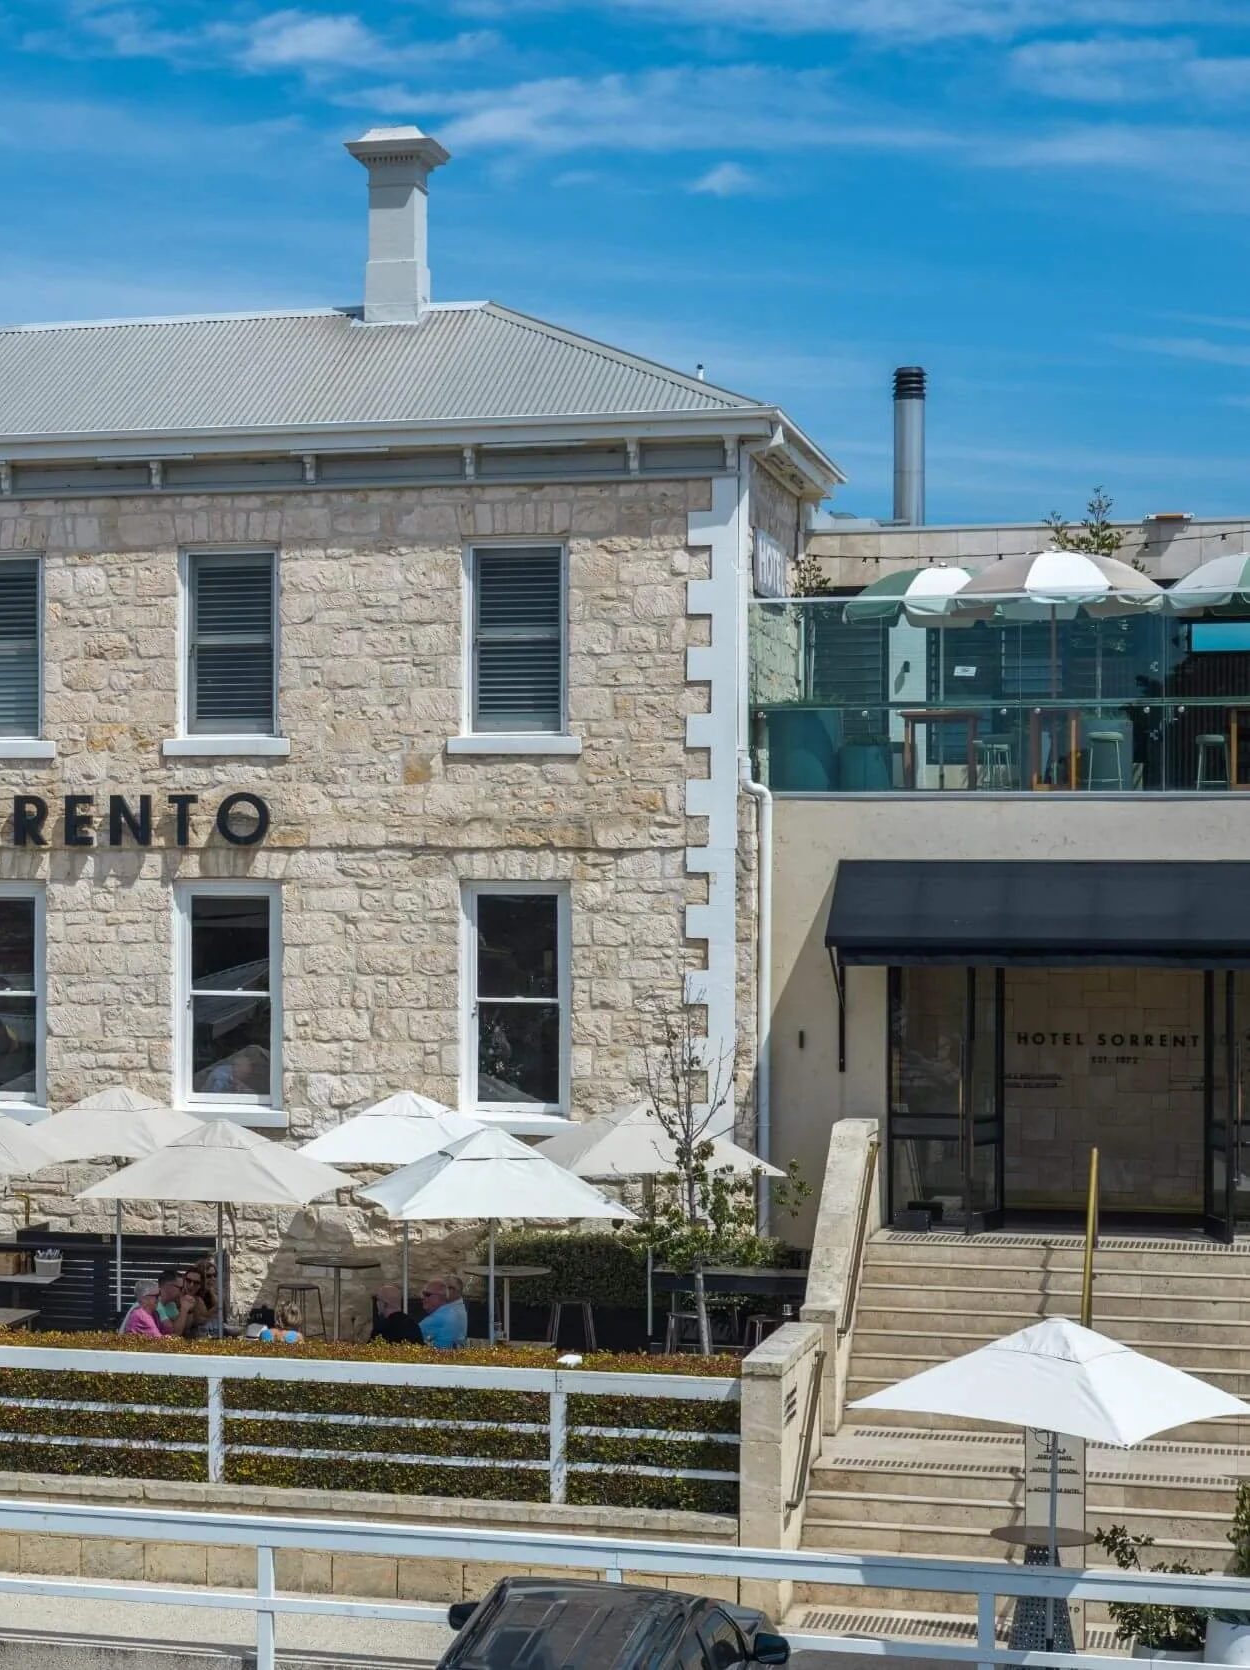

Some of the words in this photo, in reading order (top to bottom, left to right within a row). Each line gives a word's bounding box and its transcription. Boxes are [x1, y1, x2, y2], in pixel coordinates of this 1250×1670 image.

[758, 536, 786, 598] HOTEL
[1016, 1031, 1084, 1046] HOTEL
[1097, 1033, 1214, 1048] SORRENT
